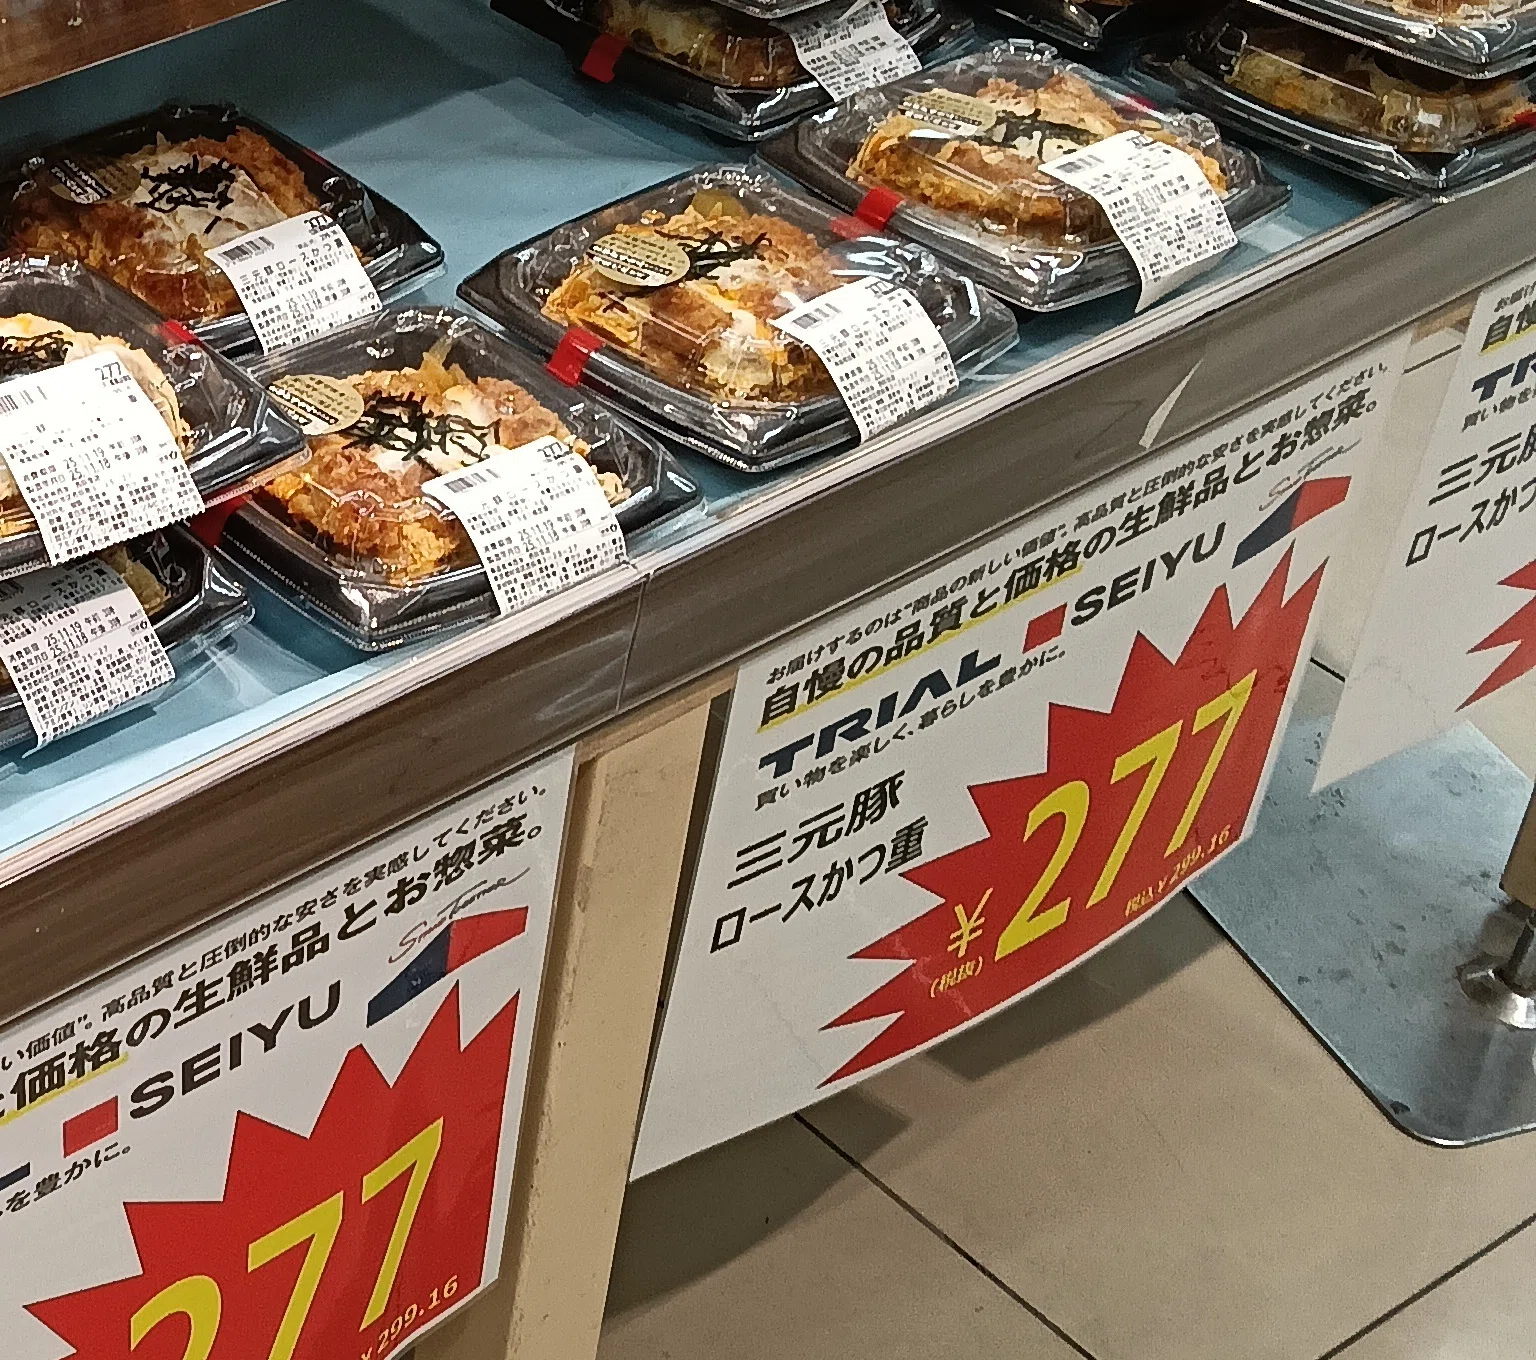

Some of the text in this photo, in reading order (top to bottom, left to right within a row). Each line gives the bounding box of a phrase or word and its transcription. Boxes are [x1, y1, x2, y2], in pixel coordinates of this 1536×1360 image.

[760, 387, 1377, 728] 自慢の品質と価格の生鮮品とお惣菜。
[1070, 521, 1227, 627] SEIYU
[758, 649, 1003, 780] TRIAL
[726, 770, 907, 890] 三元豚
[994, 668, 1258, 962] 277
[709, 816, 928, 955] ロースかつ重
[930, 955, 984, 1000] (税抜)
[129, 979, 341, 1120] SEIYU
[376, 1273, 459, 1354] 299.16
